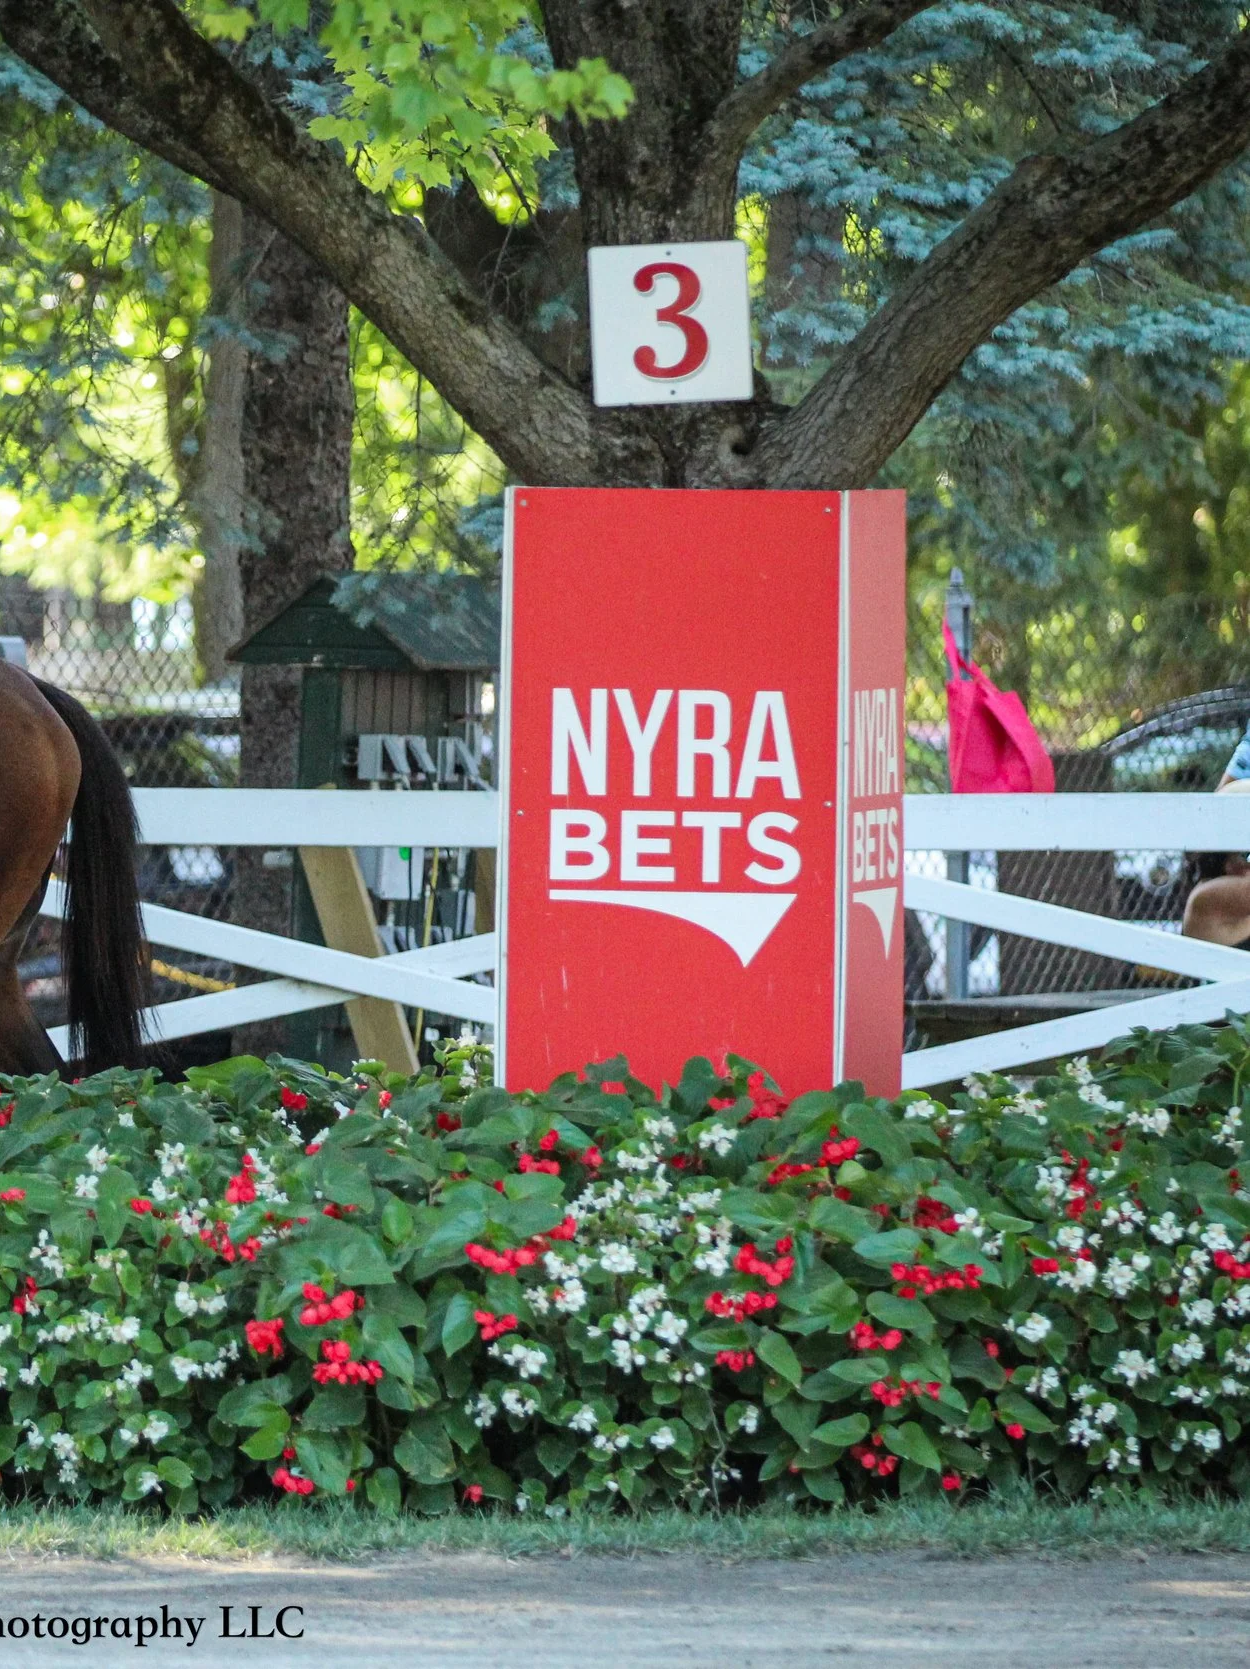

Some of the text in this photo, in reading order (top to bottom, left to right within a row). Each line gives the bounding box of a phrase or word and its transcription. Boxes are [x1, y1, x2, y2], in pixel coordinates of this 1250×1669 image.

[633, 262, 709, 380] 3
[551, 687, 802, 799] NYRA
[854, 688, 899, 798] NYRA
[549, 808, 802, 885] BETS
[853, 807, 899, 883] BETS
